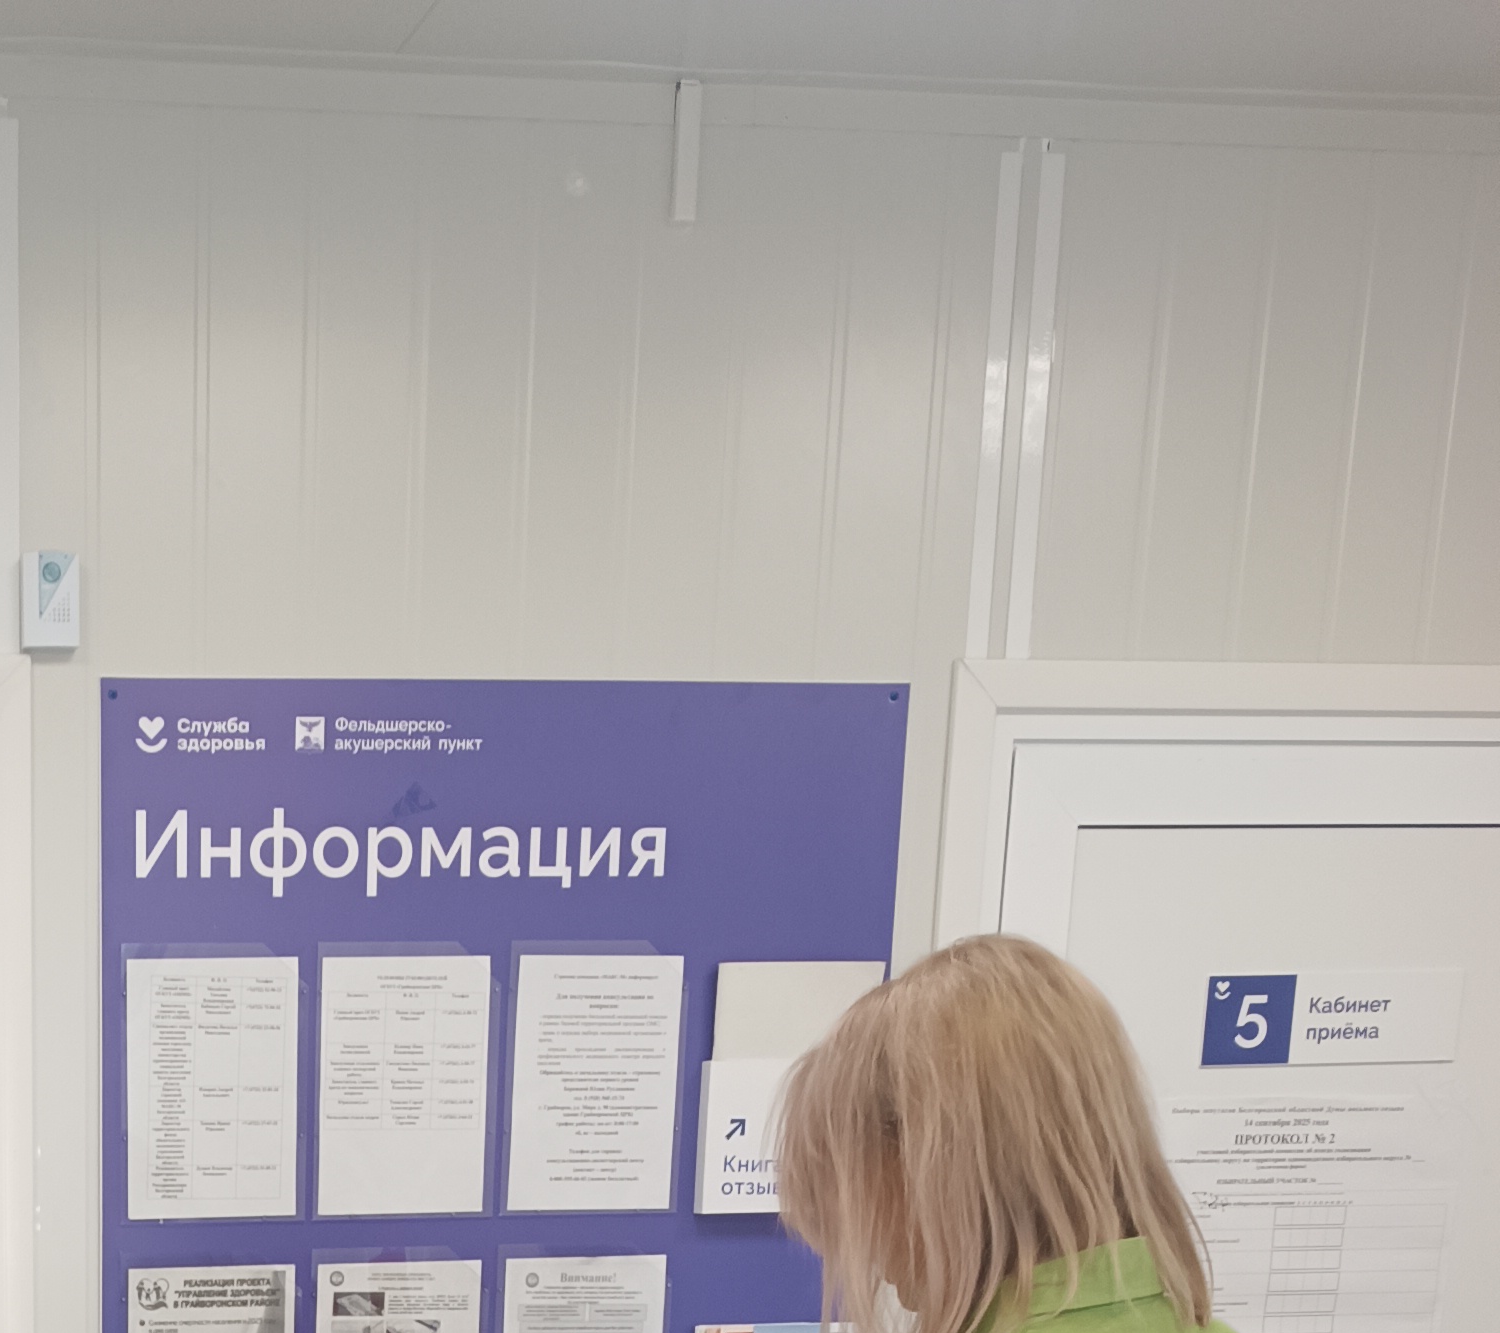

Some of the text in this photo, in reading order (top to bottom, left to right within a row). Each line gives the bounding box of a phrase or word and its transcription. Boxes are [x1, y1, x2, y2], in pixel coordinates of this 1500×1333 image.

[177, 717, 250, 736] Служба
[334, 716, 452, 735] Фельдшерско-
[177, 736, 266, 754] здоровья
[334, 735, 483, 754] акушерский пункт
[135, 808, 668, 897] Информация
[1309, 996, 1391, 1014] Кабинет
[1234, 994, 1268, 1049] 5
[1305, 1022, 1379, 1044] приёма
[1234, 1133, 1309, 1145] ПРОТОКОЛ
[1329, 1133, 1336, 1144] 2
